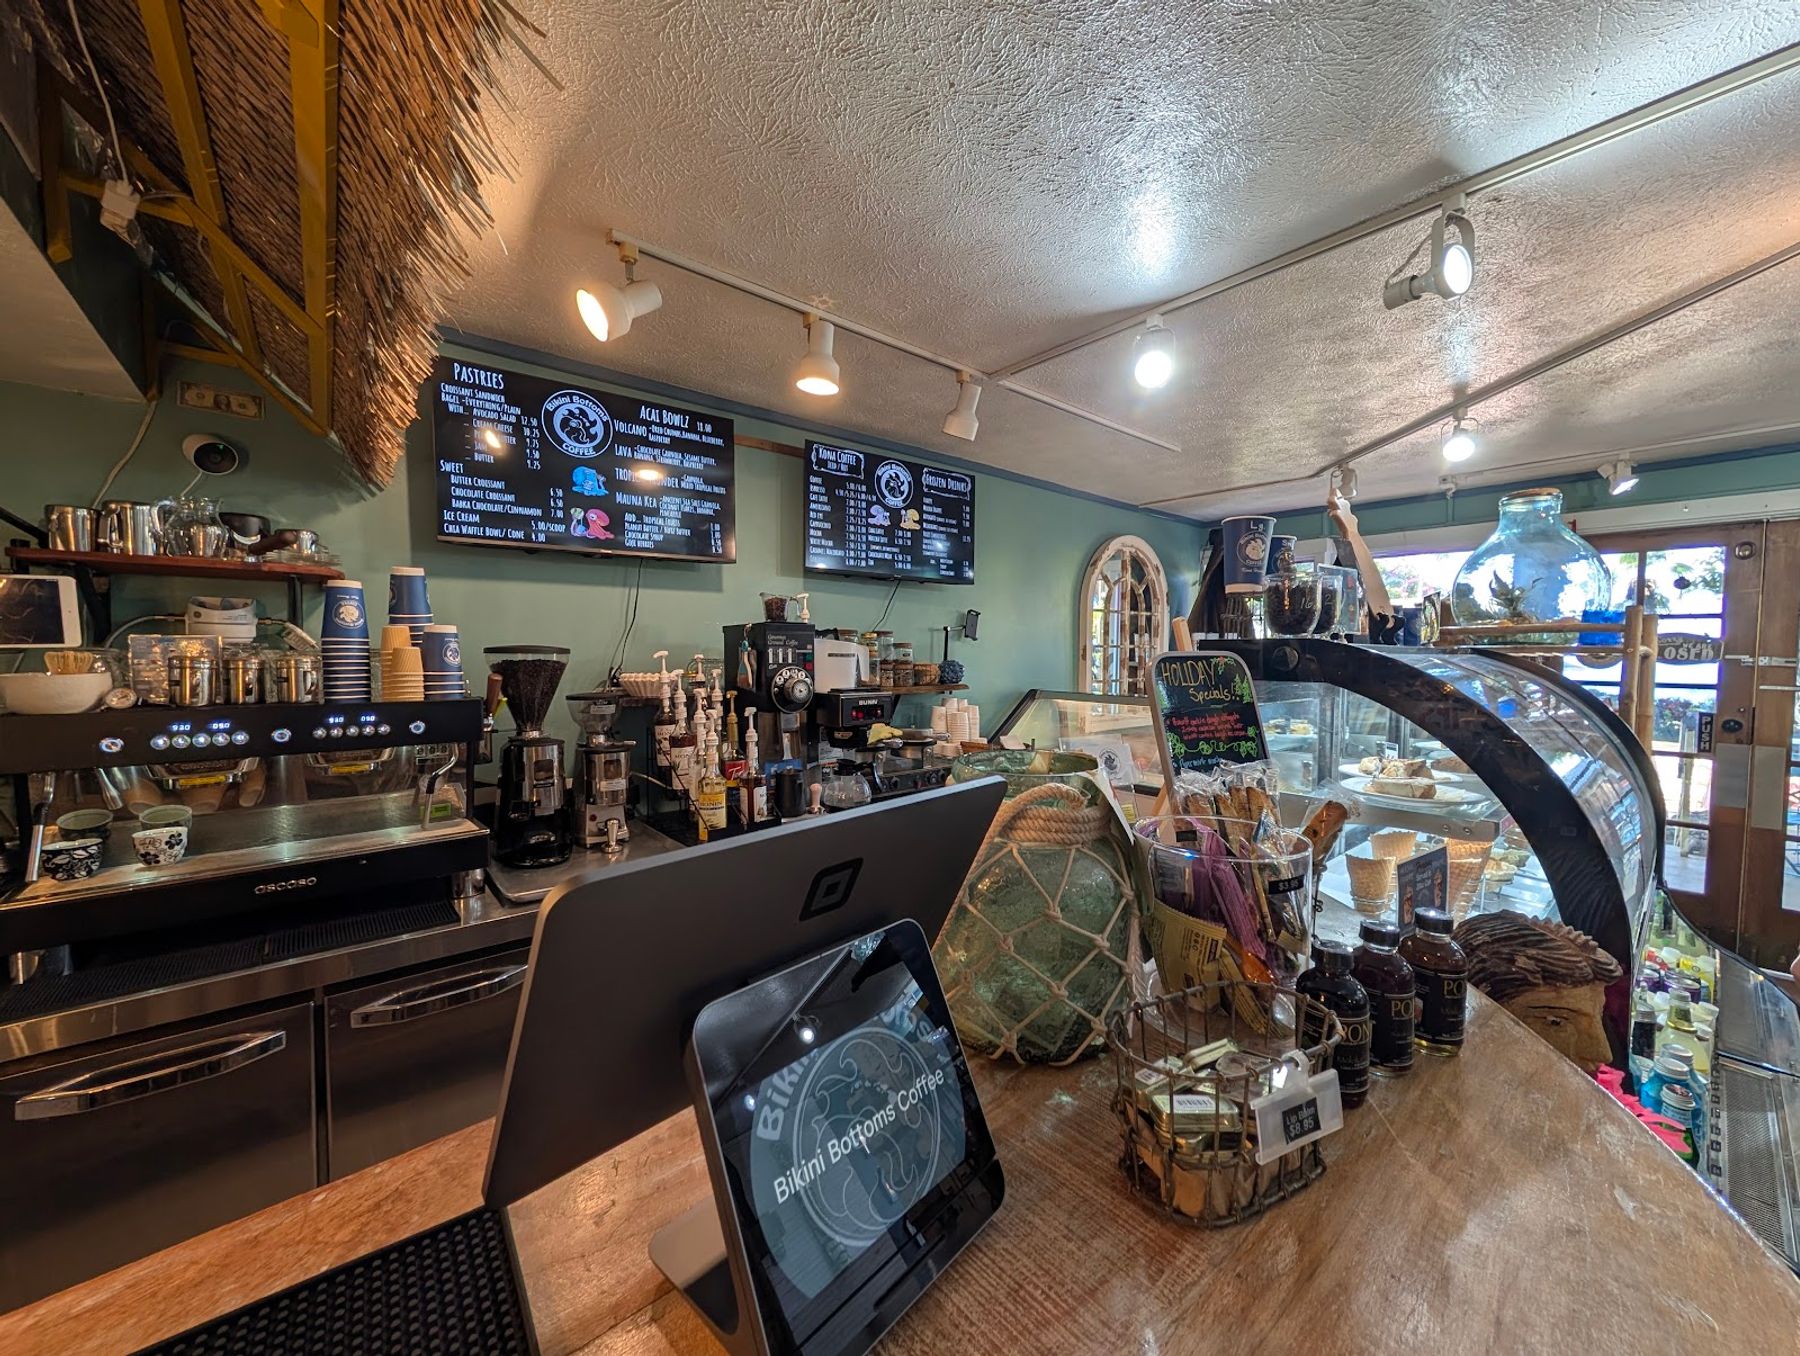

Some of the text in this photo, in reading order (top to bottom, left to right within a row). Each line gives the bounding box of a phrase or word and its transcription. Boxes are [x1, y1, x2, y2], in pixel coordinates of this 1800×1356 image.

[453, 362, 504, 389] PASTRIES
[440, 382, 505, 403] CROISSANT SANDWICH
[441, 392, 460, 403] BAGEL
[472, 407, 498, 420] AVOCADO
[499, 412, 516, 423] SALAD
[546, 395, 609, 422] Bikini Bottoms
[640, 405, 660, 422] ACAI
[662, 409, 690, 428] BOWLZ
[614, 419, 647, 437] VOLCANO
[562, 442, 596, 455] COFFEE
[614, 443, 632, 458] LAVA
[440, 460, 464, 473] SWEET
[450, 474, 472, 486] BUTTER
[473, 477, 505, 489] CROISSANT
[451, 486, 484, 499] CHOCOLATE
[615, 491, 642, 506] MAUNA
[643, 495, 657, 508] KEA
[443, 510, 480, 523] ICE CREAM
[461, 525, 483, 536] WAFFLE
[507, 528, 525, 539] CONE
[1162, 659, 1215, 686] HOLIDAY
[1701, 716, 1712, 750] PUSH
[773, 1068, 944, 1204] Bikini Bottoms Coffee
